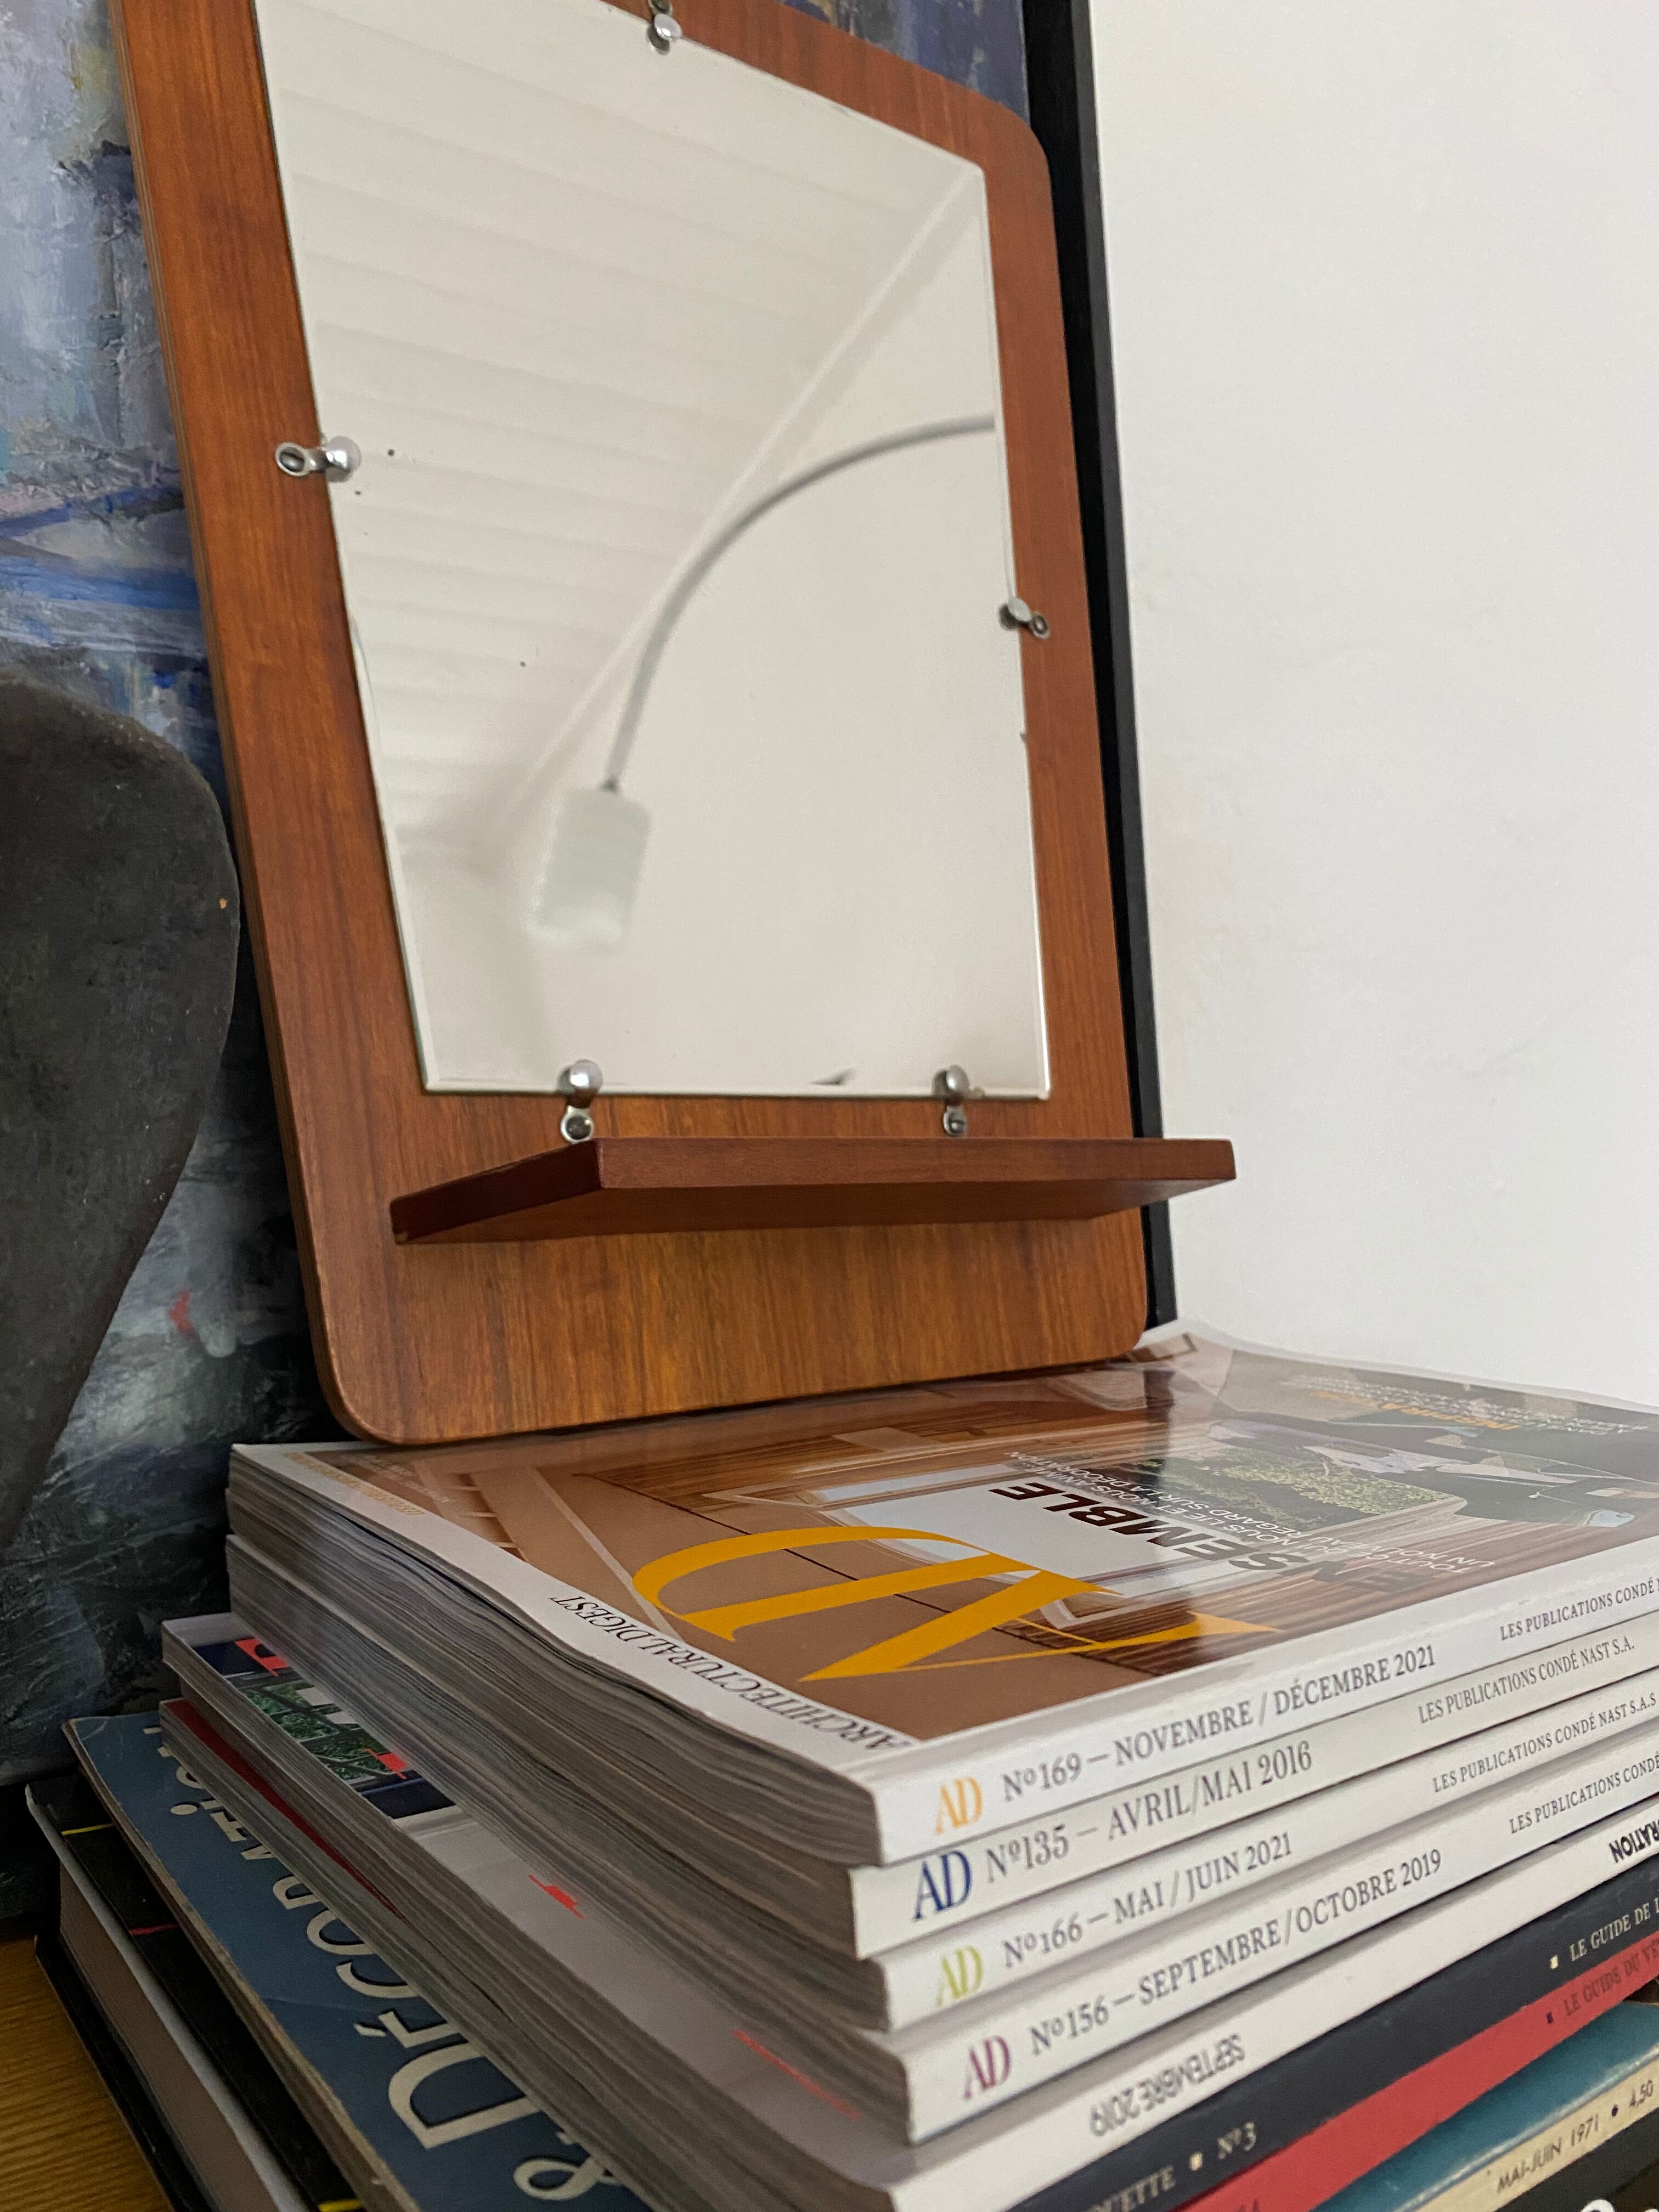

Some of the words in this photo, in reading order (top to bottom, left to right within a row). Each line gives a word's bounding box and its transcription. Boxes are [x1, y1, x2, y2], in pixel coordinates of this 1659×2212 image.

[1090, 1485, 1158, 1505] NOUS
[1130, 1486, 1163, 1496] LA
[1156, 1505, 1189, 1514] ET
[1158, 1494, 1210, 1510] SUR
[1184, 1513, 1226, 1526] LIE
[1209, 1509, 1302, 1538] REGARD
[1223, 1524, 1300, 1546] NOUS
[549, 1595, 655, 1642] DIGEST
[633, 1526, 1280, 1681] AD
[1500, 1620, 1523, 1640] LES
[1525, 1593, 1613, 1633] PUBLICATIONS
[1616, 1576, 1655, 1604] CONDÉ
[639, 1638, 912, 1750] ARCHITECTURAL
[1419, 1700, 1444, 1723] LES
[1446, 1667, 1537, 1714] PUBLICATIONS
[1539, 1649, 1579, 1680] CONDÉ
[1581, 1642, 1610, 1667] NAST
[1612, 1636, 1635, 1656] S.A.
[934, 1776, 983, 1835] AD
[1114, 1700, 1254, 1765] NOVEMBRE
[1273, 1658, 1391, 1716] DÉCEMBRE
[1395, 1645, 1435, 1677] 2021
[1432, 1770, 1458, 1793] LES
[1459, 1733, 1553, 1783] PUBLICATIONS
[1555, 1712, 1597, 1743] CONDÉ
[1598, 1703, 1628, 1727] NAST
[1510, 1812, 1533, 1835] LES
[1535, 1773, 1621, 1823] PUBLICATIONS
[1623, 1751, 1659, 1783] CONDÉ
[912, 1850, 973, 1921] AD
[1258, 1740, 1312, 1785] 2016
[1609, 1817, 1659, 1864] RATION
[935, 1945, 984, 2007] AD
[1114, 1880, 1165, 1924] MAI
[1186, 1850, 1240, 1903] JUIN
[1245, 1832, 1293, 1871] 2021
[1569, 1938, 1588, 1961] LE
[1590, 1914, 1632, 1949] GUIDE
[1634, 1903, 1651, 1925] DE
[962, 2035, 1012, 2100] AD
[1401, 1849, 1442, 1887] 2019
[1571, 2114, 1599, 2147] 1971
